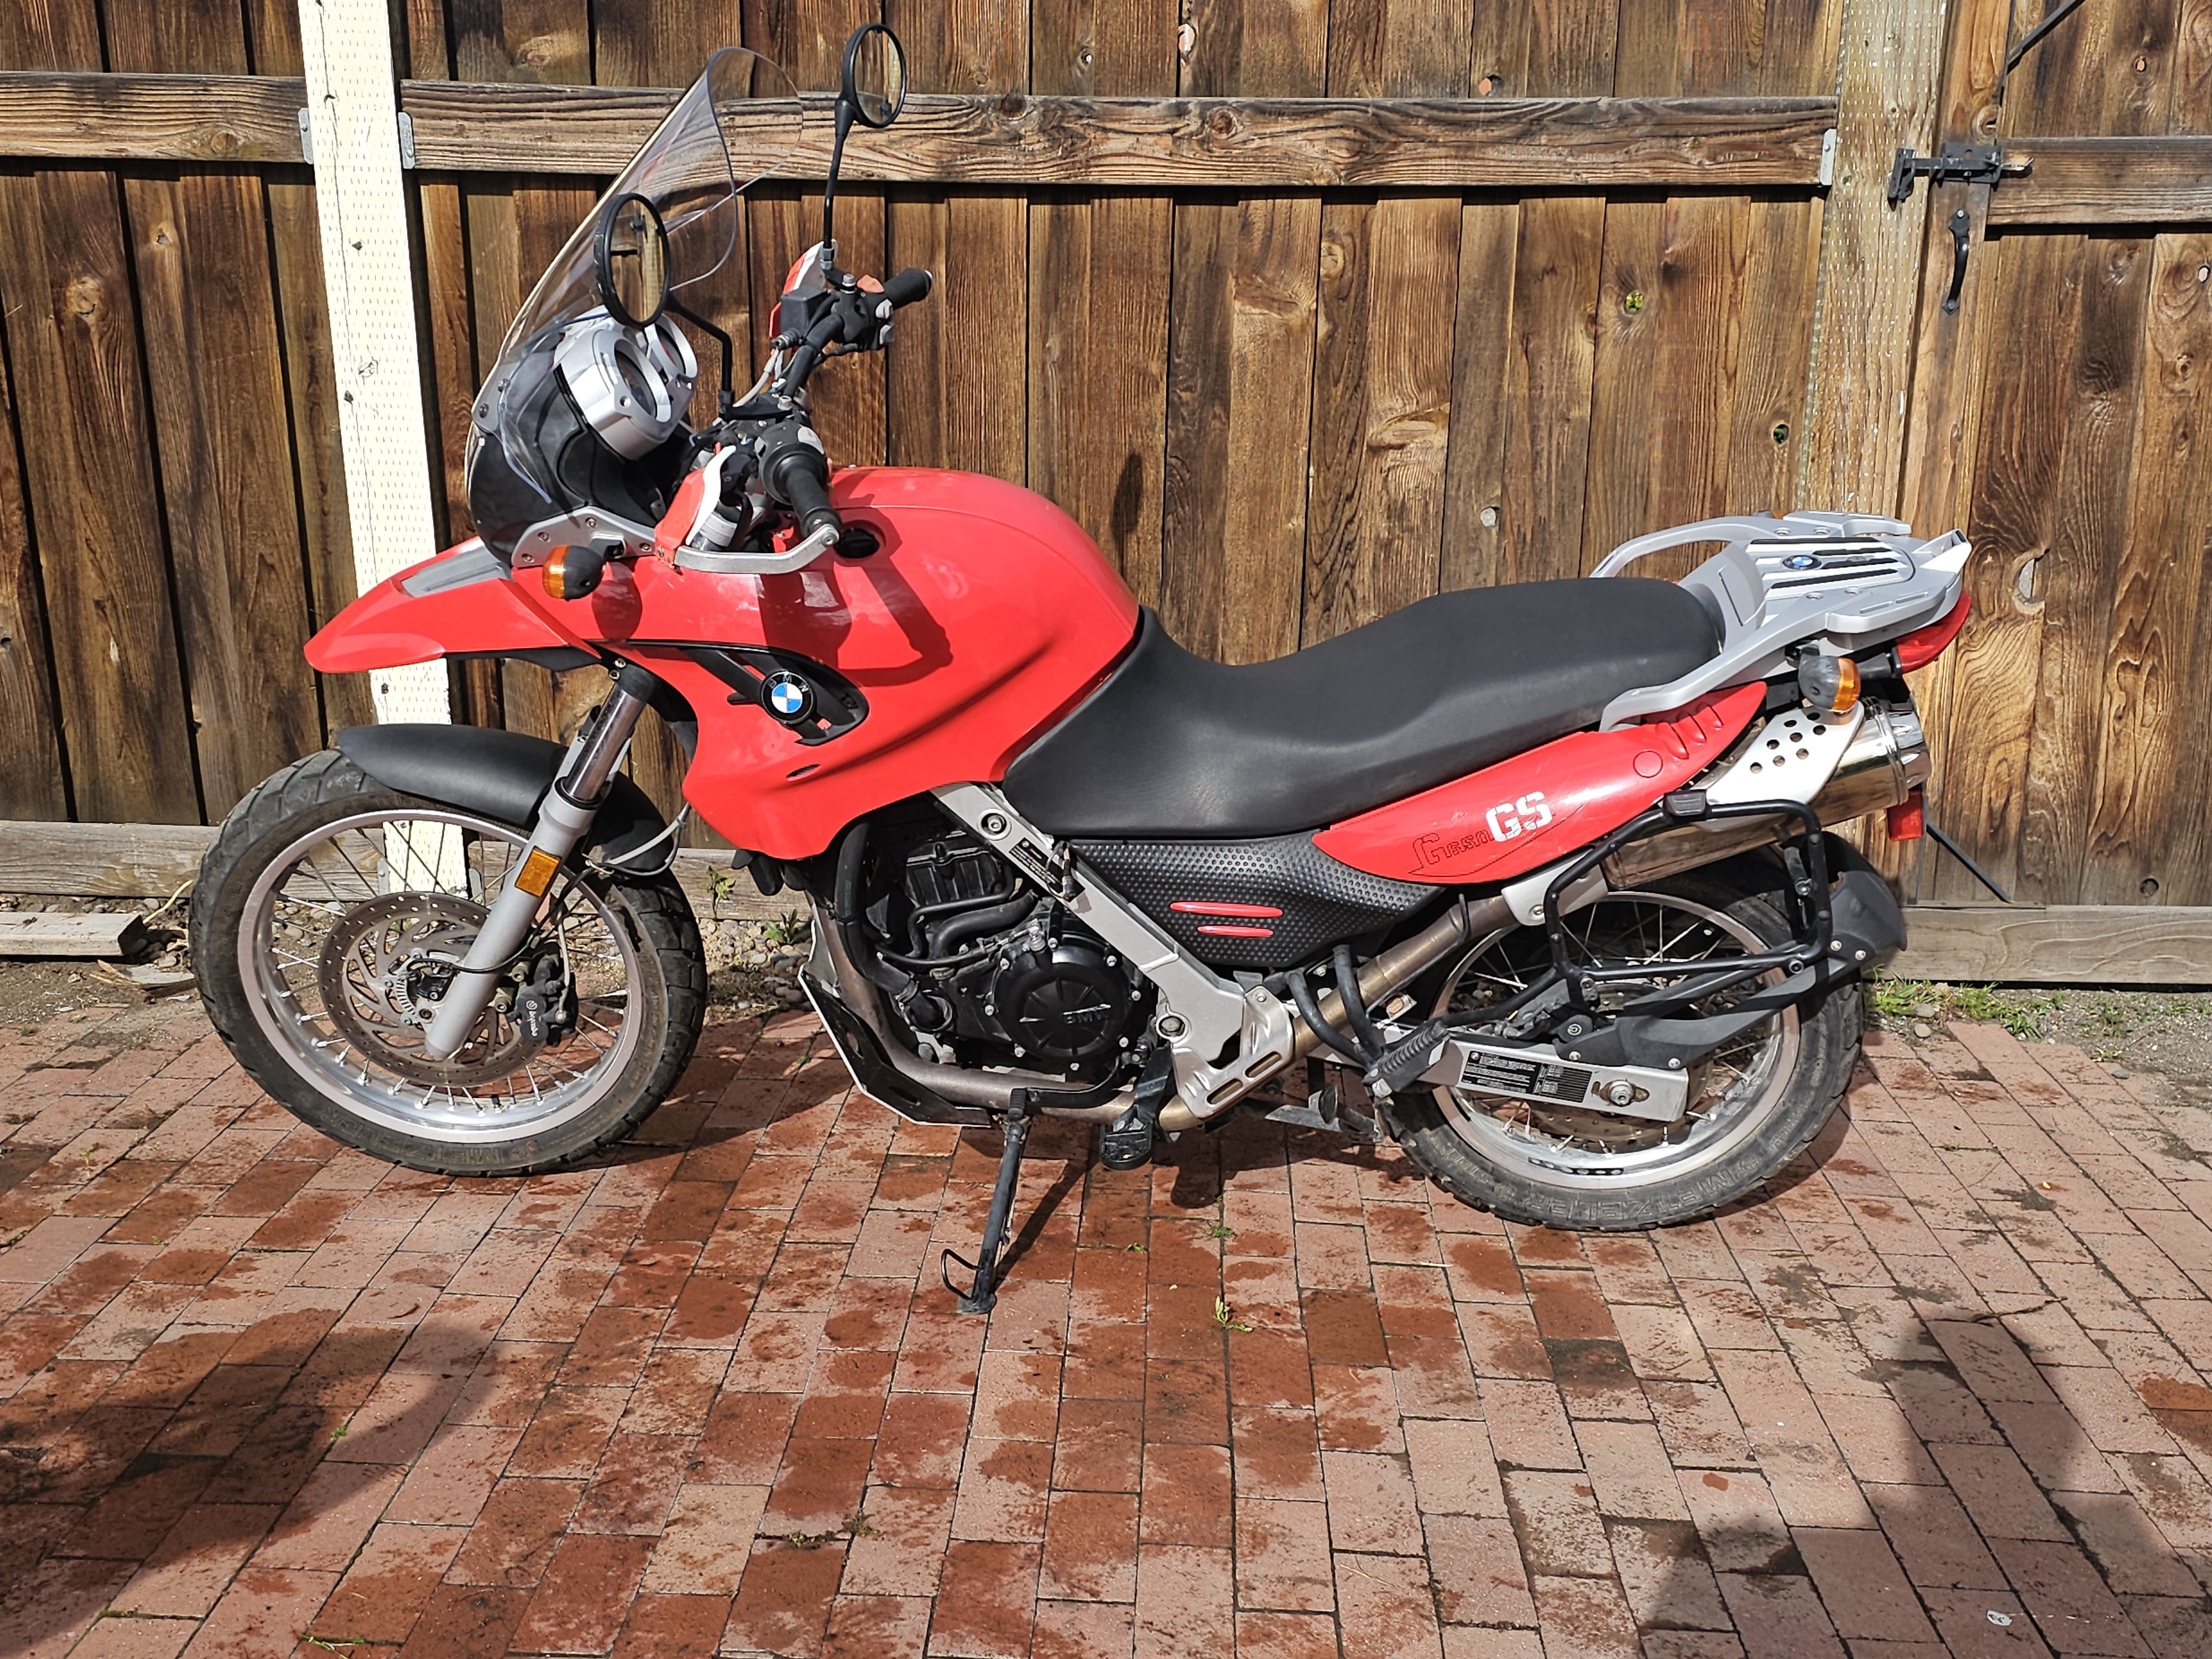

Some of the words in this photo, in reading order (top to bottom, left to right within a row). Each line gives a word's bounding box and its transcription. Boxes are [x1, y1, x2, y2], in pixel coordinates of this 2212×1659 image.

[768, 671, 810, 692] BMW
[1485, 791, 1553, 842] GS
[1063, 1004, 1111, 1024] BMW
[319, 1107, 503, 1165] METZELER
[1523, 1168, 1736, 1220] METZELER
